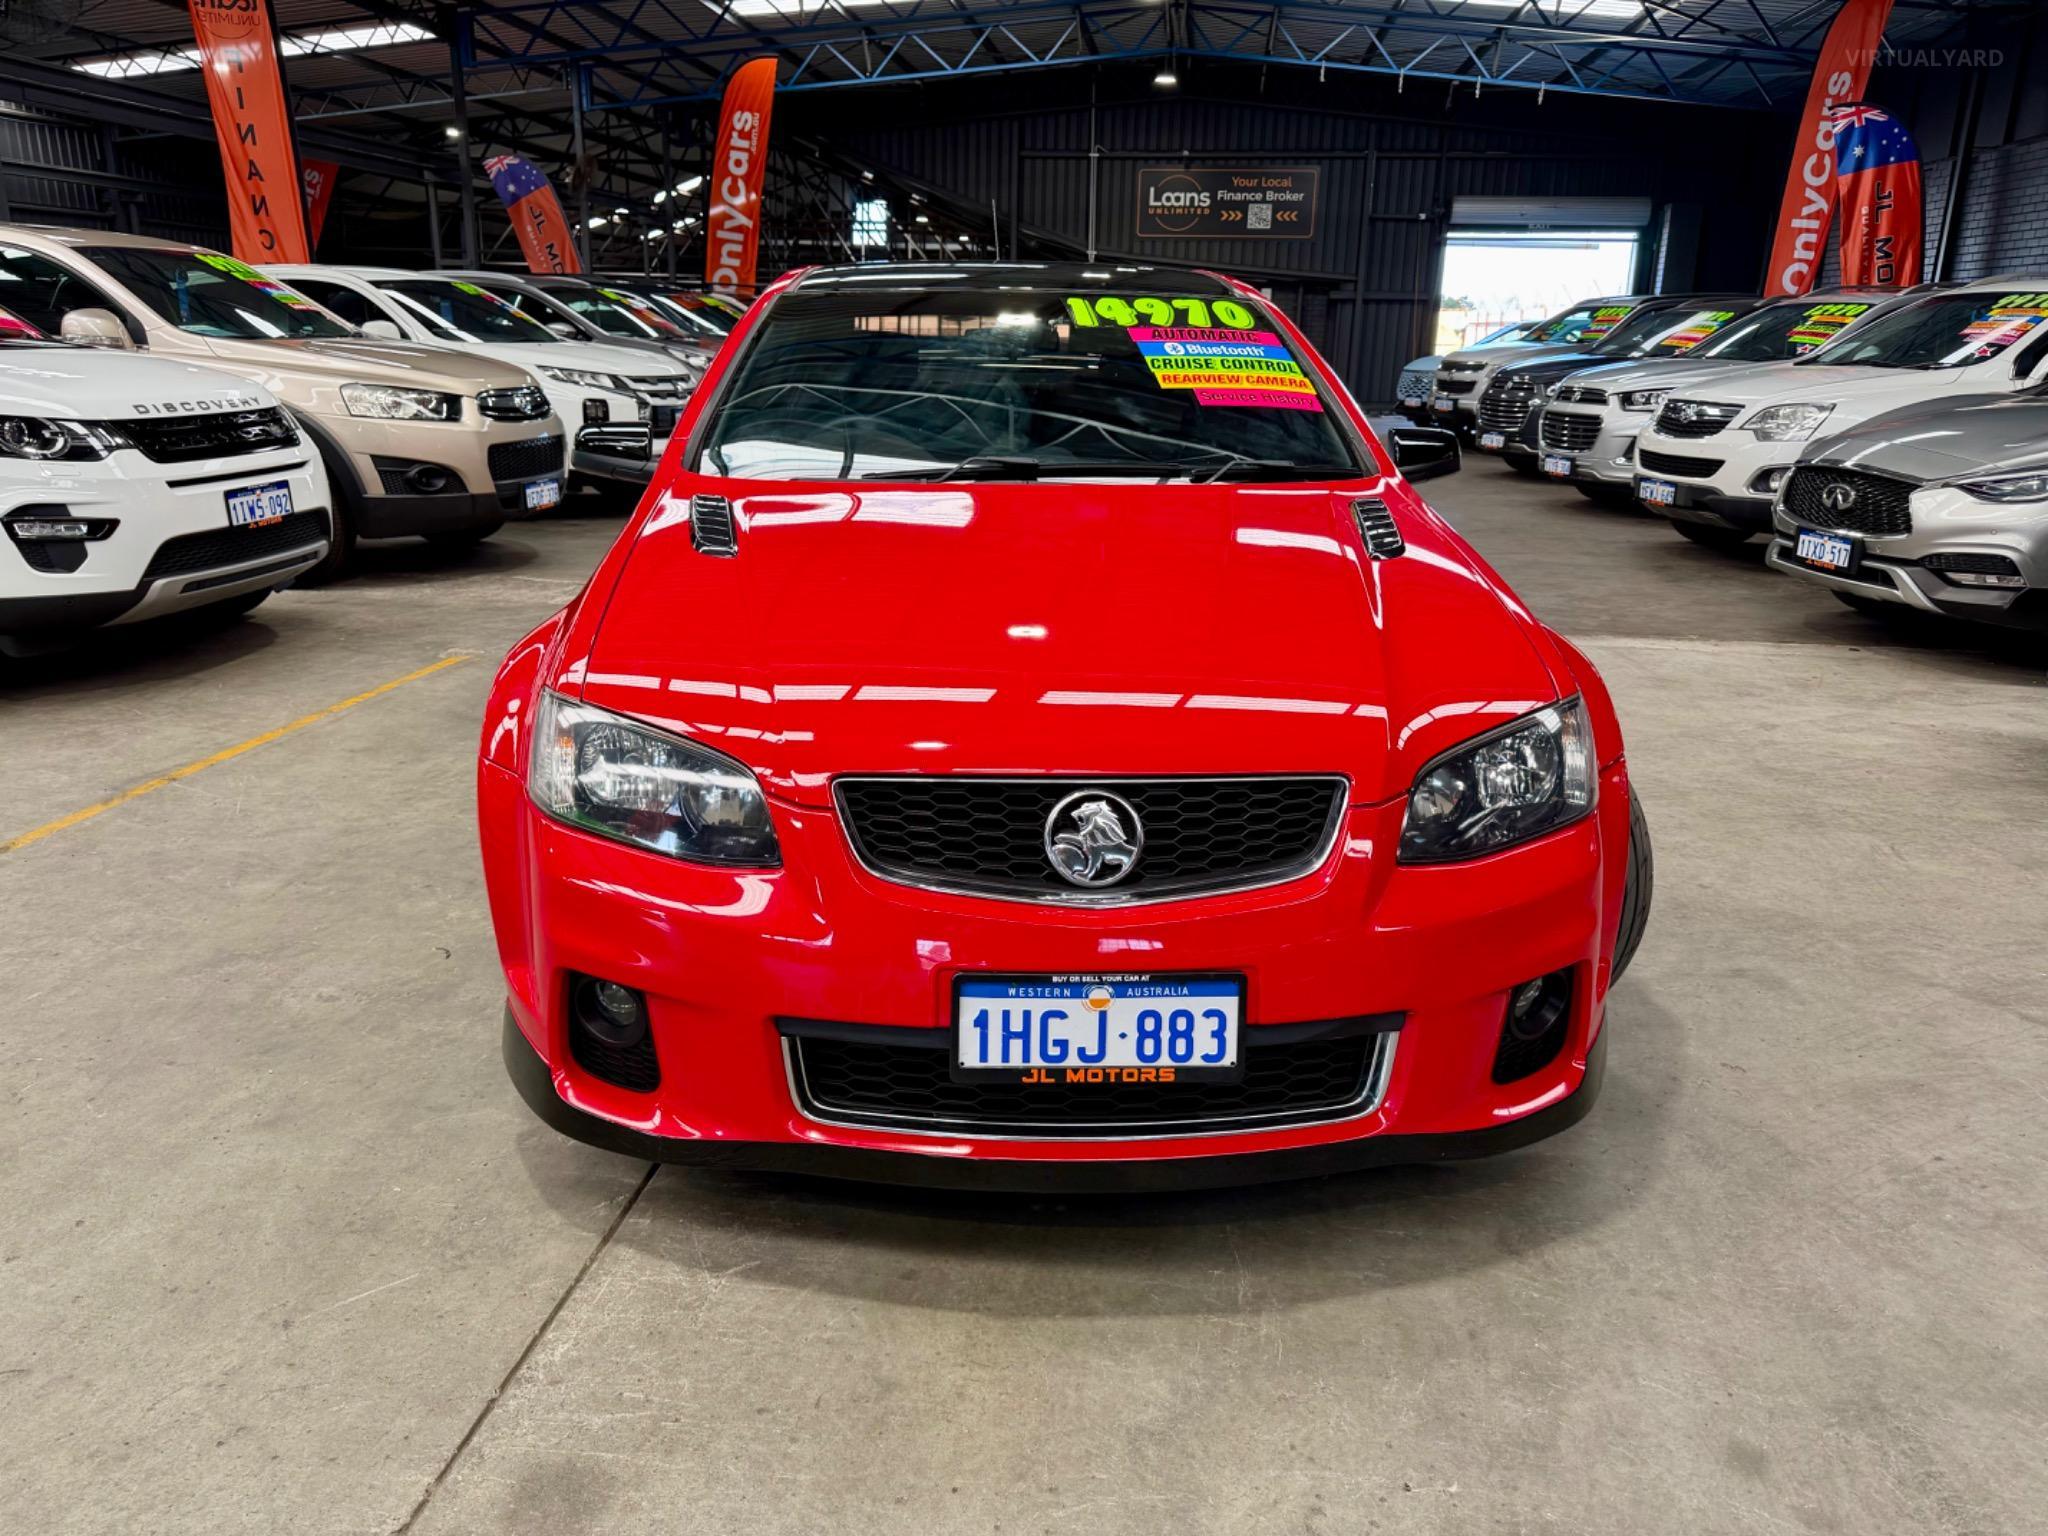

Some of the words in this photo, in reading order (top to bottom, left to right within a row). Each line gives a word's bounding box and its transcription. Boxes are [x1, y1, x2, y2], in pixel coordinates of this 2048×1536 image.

[1232, 176, 1259, 187] Your
[1262, 176, 1292, 187] Local
[1149, 186, 1211, 207] Loans
[1217, 190, 1263, 201] Finance
[1266, 190, 1305, 201] Broker
[1875, 181, 1894, 224] JL
[1067, 297, 1256, 329] 14970
[1152, 329, 1259, 343] AUTOMATIC
[1186, 343, 1265, 357] Bluetooth
[1151, 357, 1214, 370] CRUISE
[1222, 360, 1298, 374] CONTROL
[1161, 374, 1243, 386] REARVIEW
[1246, 375, 1308, 388] CAMERA
[133, 396, 261, 414] DISCOVERY
[1201, 391, 1257, 402] Service
[1263, 393, 1315, 407] History
[1008, 988, 1071, 997] WESTERN
[1127, 986, 1189, 996] AUSTRALIA
[1022, 1068, 1055, 1083] JL
[1066, 1068, 1176, 1083] MOTORS
